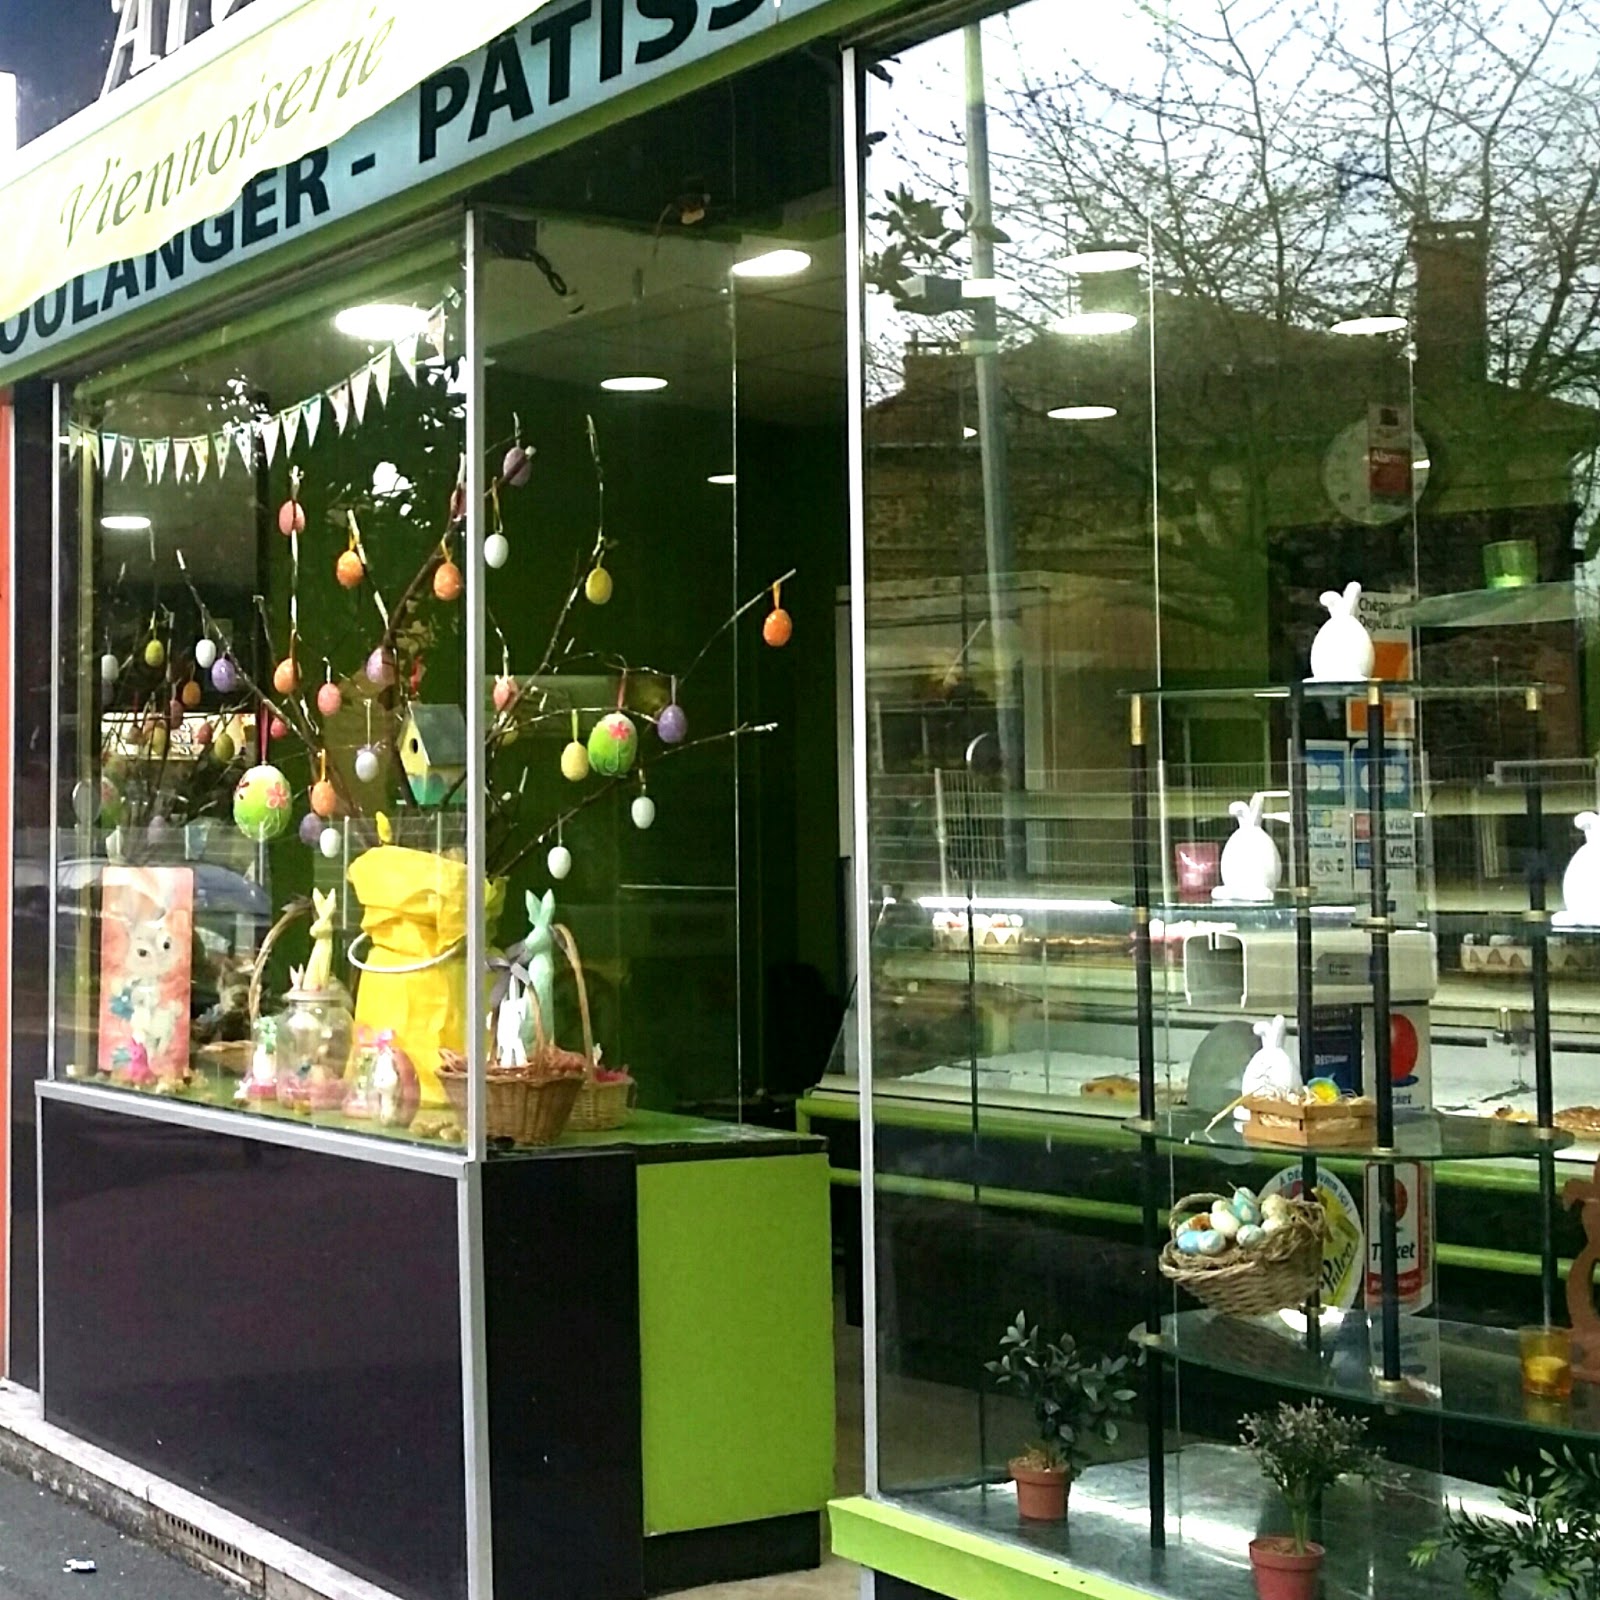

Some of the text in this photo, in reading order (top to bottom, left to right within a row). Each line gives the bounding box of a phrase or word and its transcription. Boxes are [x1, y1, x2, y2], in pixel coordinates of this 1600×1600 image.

[59, 6, 396, 249] Viennoiserie
[351, 153, 376, 176] -
[1388, 817, 1411, 830] VISA
[1388, 845, 1412, 859] VISA
[1371, 1242, 1416, 1261] Tket
